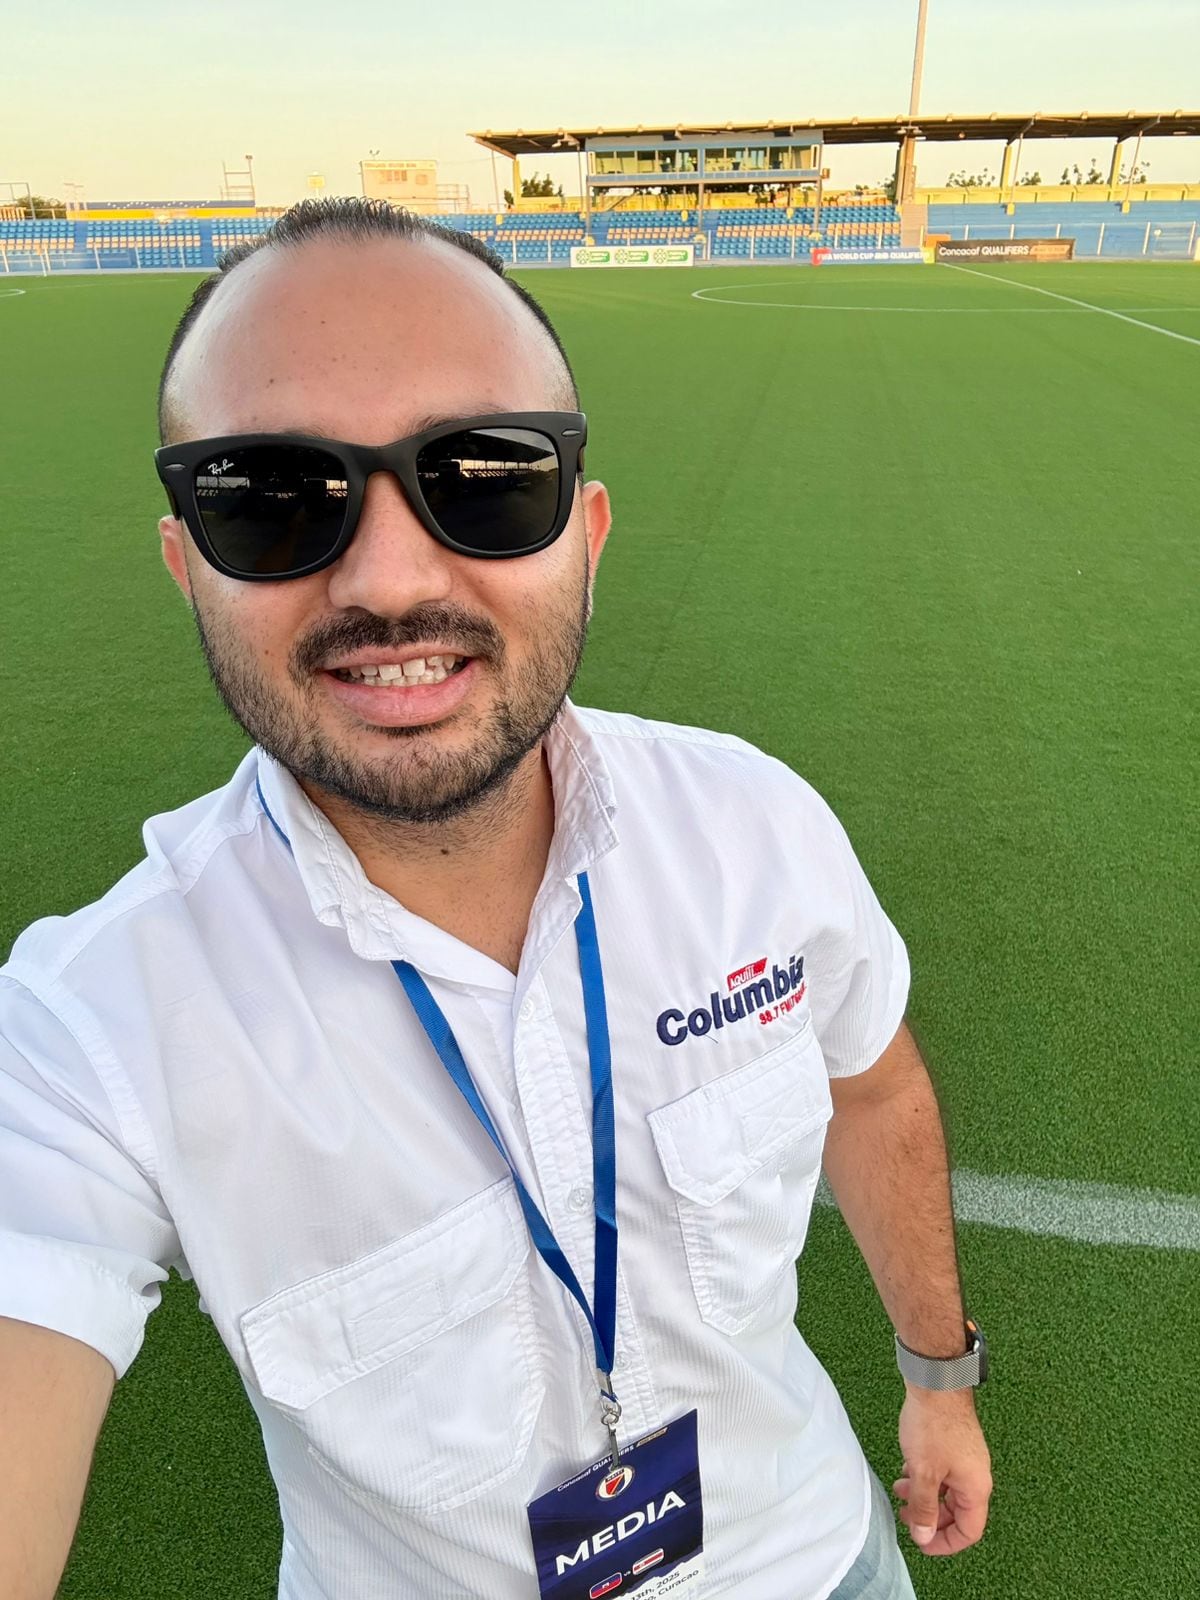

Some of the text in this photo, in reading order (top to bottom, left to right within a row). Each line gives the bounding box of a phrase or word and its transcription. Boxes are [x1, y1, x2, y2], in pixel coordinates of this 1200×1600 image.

[833, 252, 859, 260] WORLD
[860, 252, 874, 260] CUP
[938, 246, 979, 256] Concacaf
[981, 245, 1029, 256] QUALIFIERS
[656, 954, 804, 1046] Columbia
[758, 1005, 779, 1025] 98.7
[557, 1468, 591, 1492] Concacaf
[555, 1490, 687, 1576] MEDIA
[656, 1570, 680, 1589] 2025
